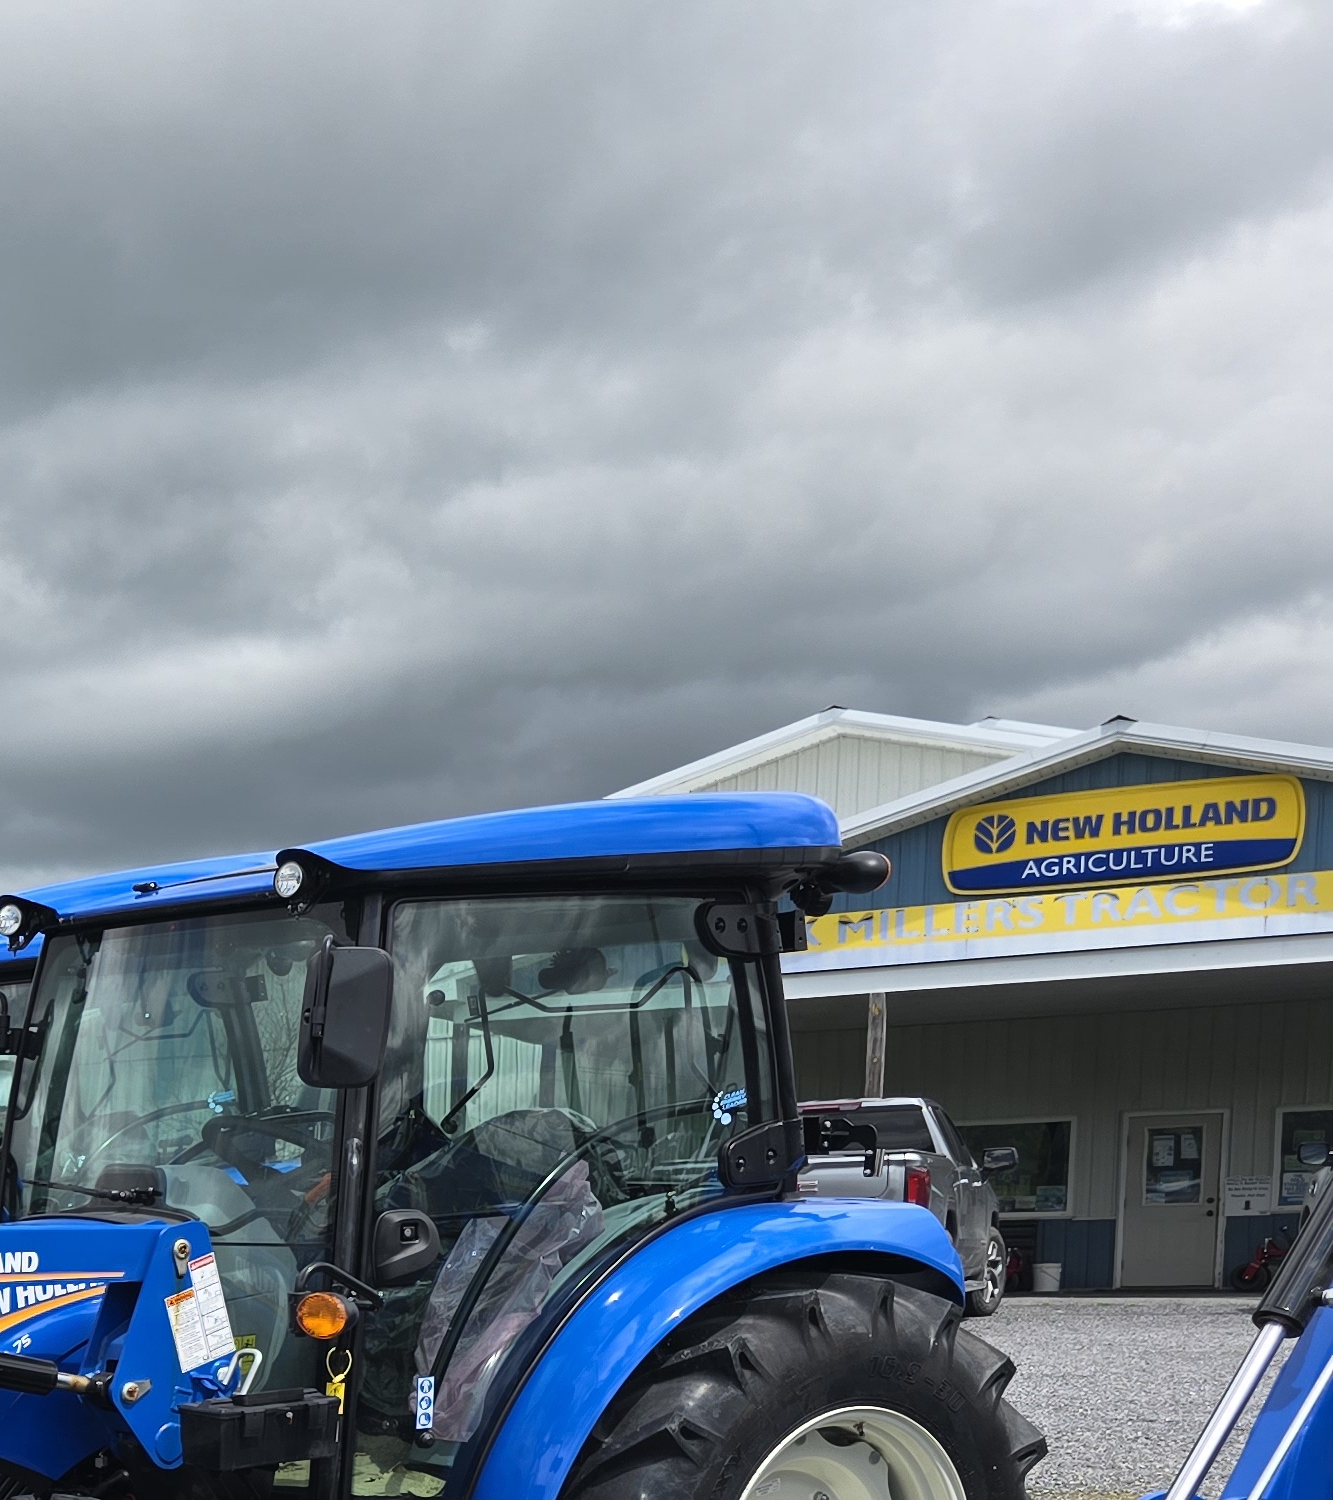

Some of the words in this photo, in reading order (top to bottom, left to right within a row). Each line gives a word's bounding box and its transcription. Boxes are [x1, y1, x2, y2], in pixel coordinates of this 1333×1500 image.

[1025, 813, 1104, 846] NEW
[1111, 796, 1278, 837] HOLLAND
[1021, 842, 1215, 880] AGRICULTURE
[1053, 874, 1320, 927] TRACTOR
[12, 1333, 32, 1354] 75
